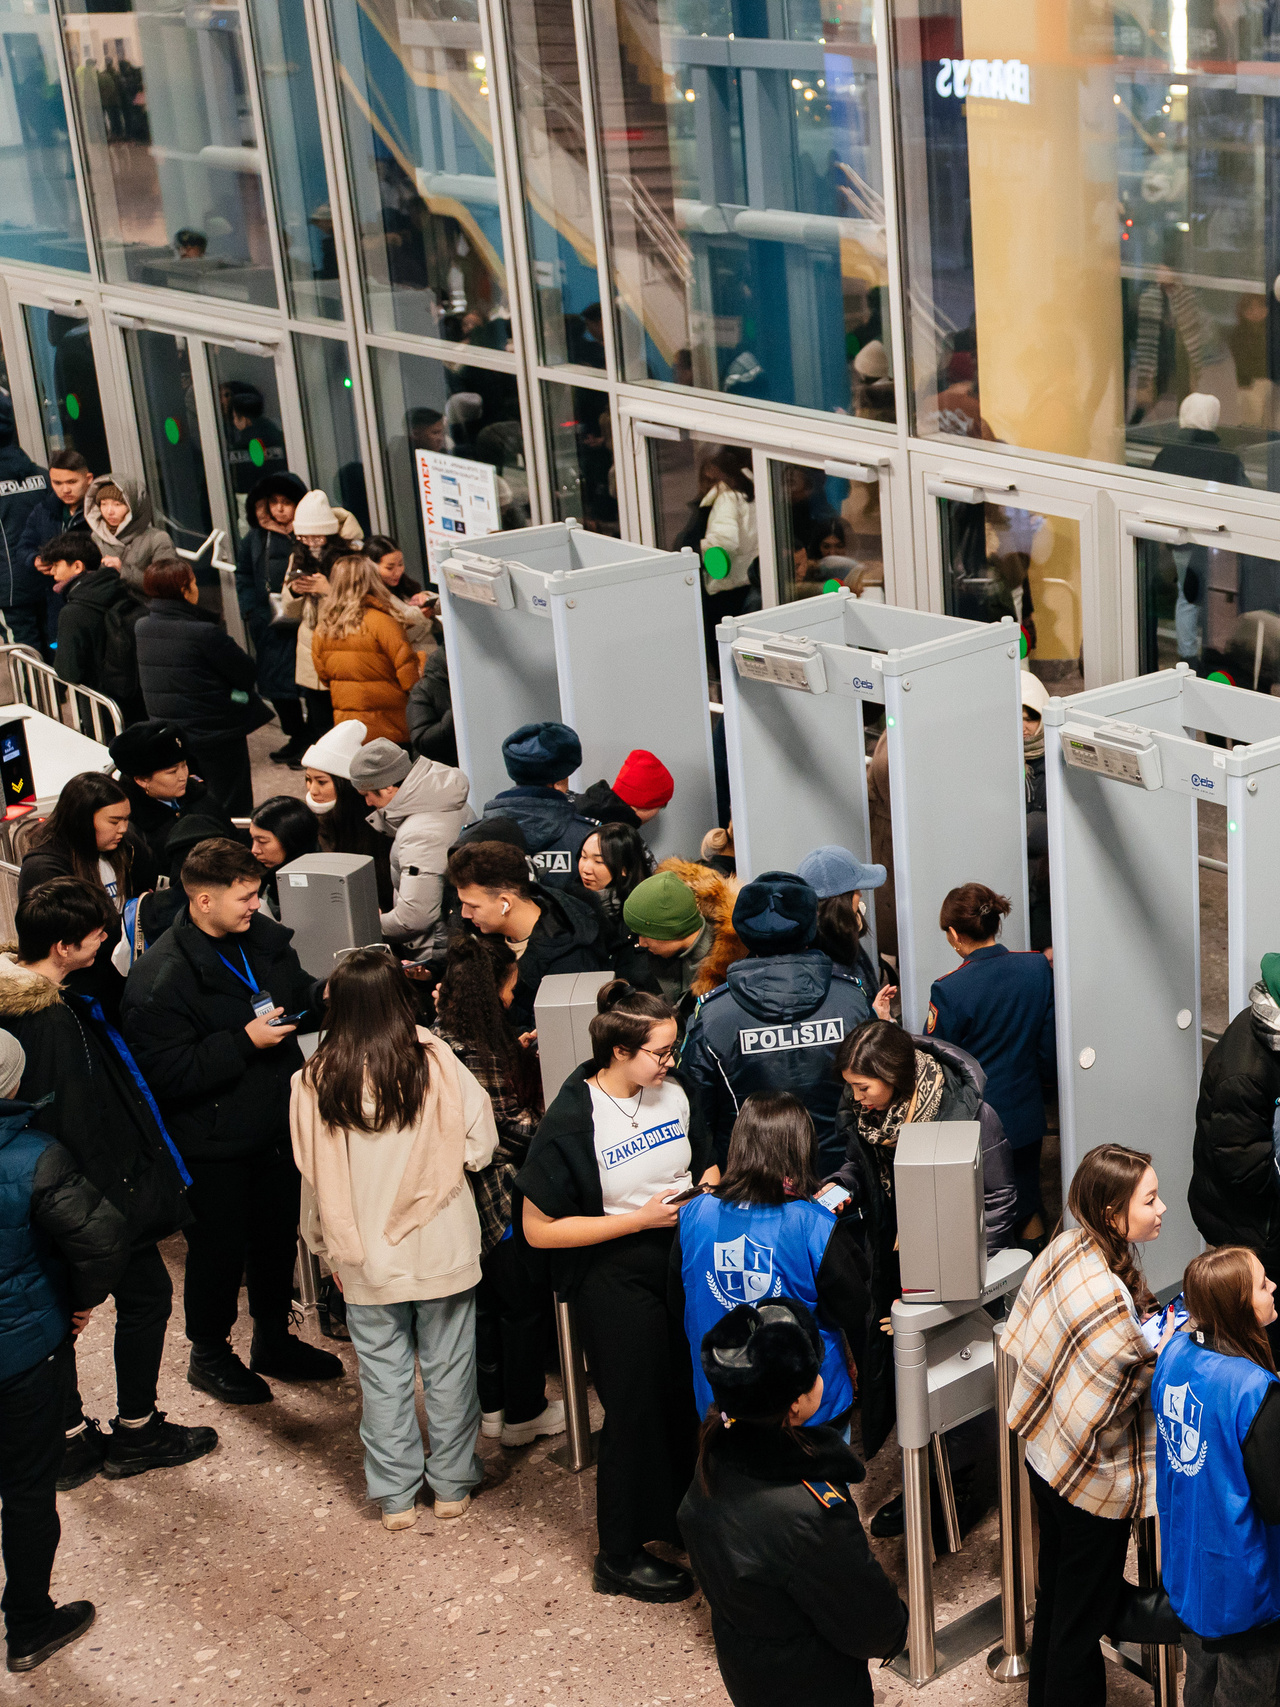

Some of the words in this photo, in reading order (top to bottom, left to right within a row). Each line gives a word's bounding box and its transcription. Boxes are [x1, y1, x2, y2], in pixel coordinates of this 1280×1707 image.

[0, 477, 45, 493] POLISIA
[744, 1022, 840, 1050] POLISIA
[606, 1137, 646, 1165] ZAKAZ
[721, 1249, 737, 1268] K
[724, 1273, 742, 1291] L
[747, 1275, 763, 1292] C
[1169, 1393, 1180, 1417] K
[1169, 1420, 1181, 1445] L
[1183, 1429, 1195, 1452] C
